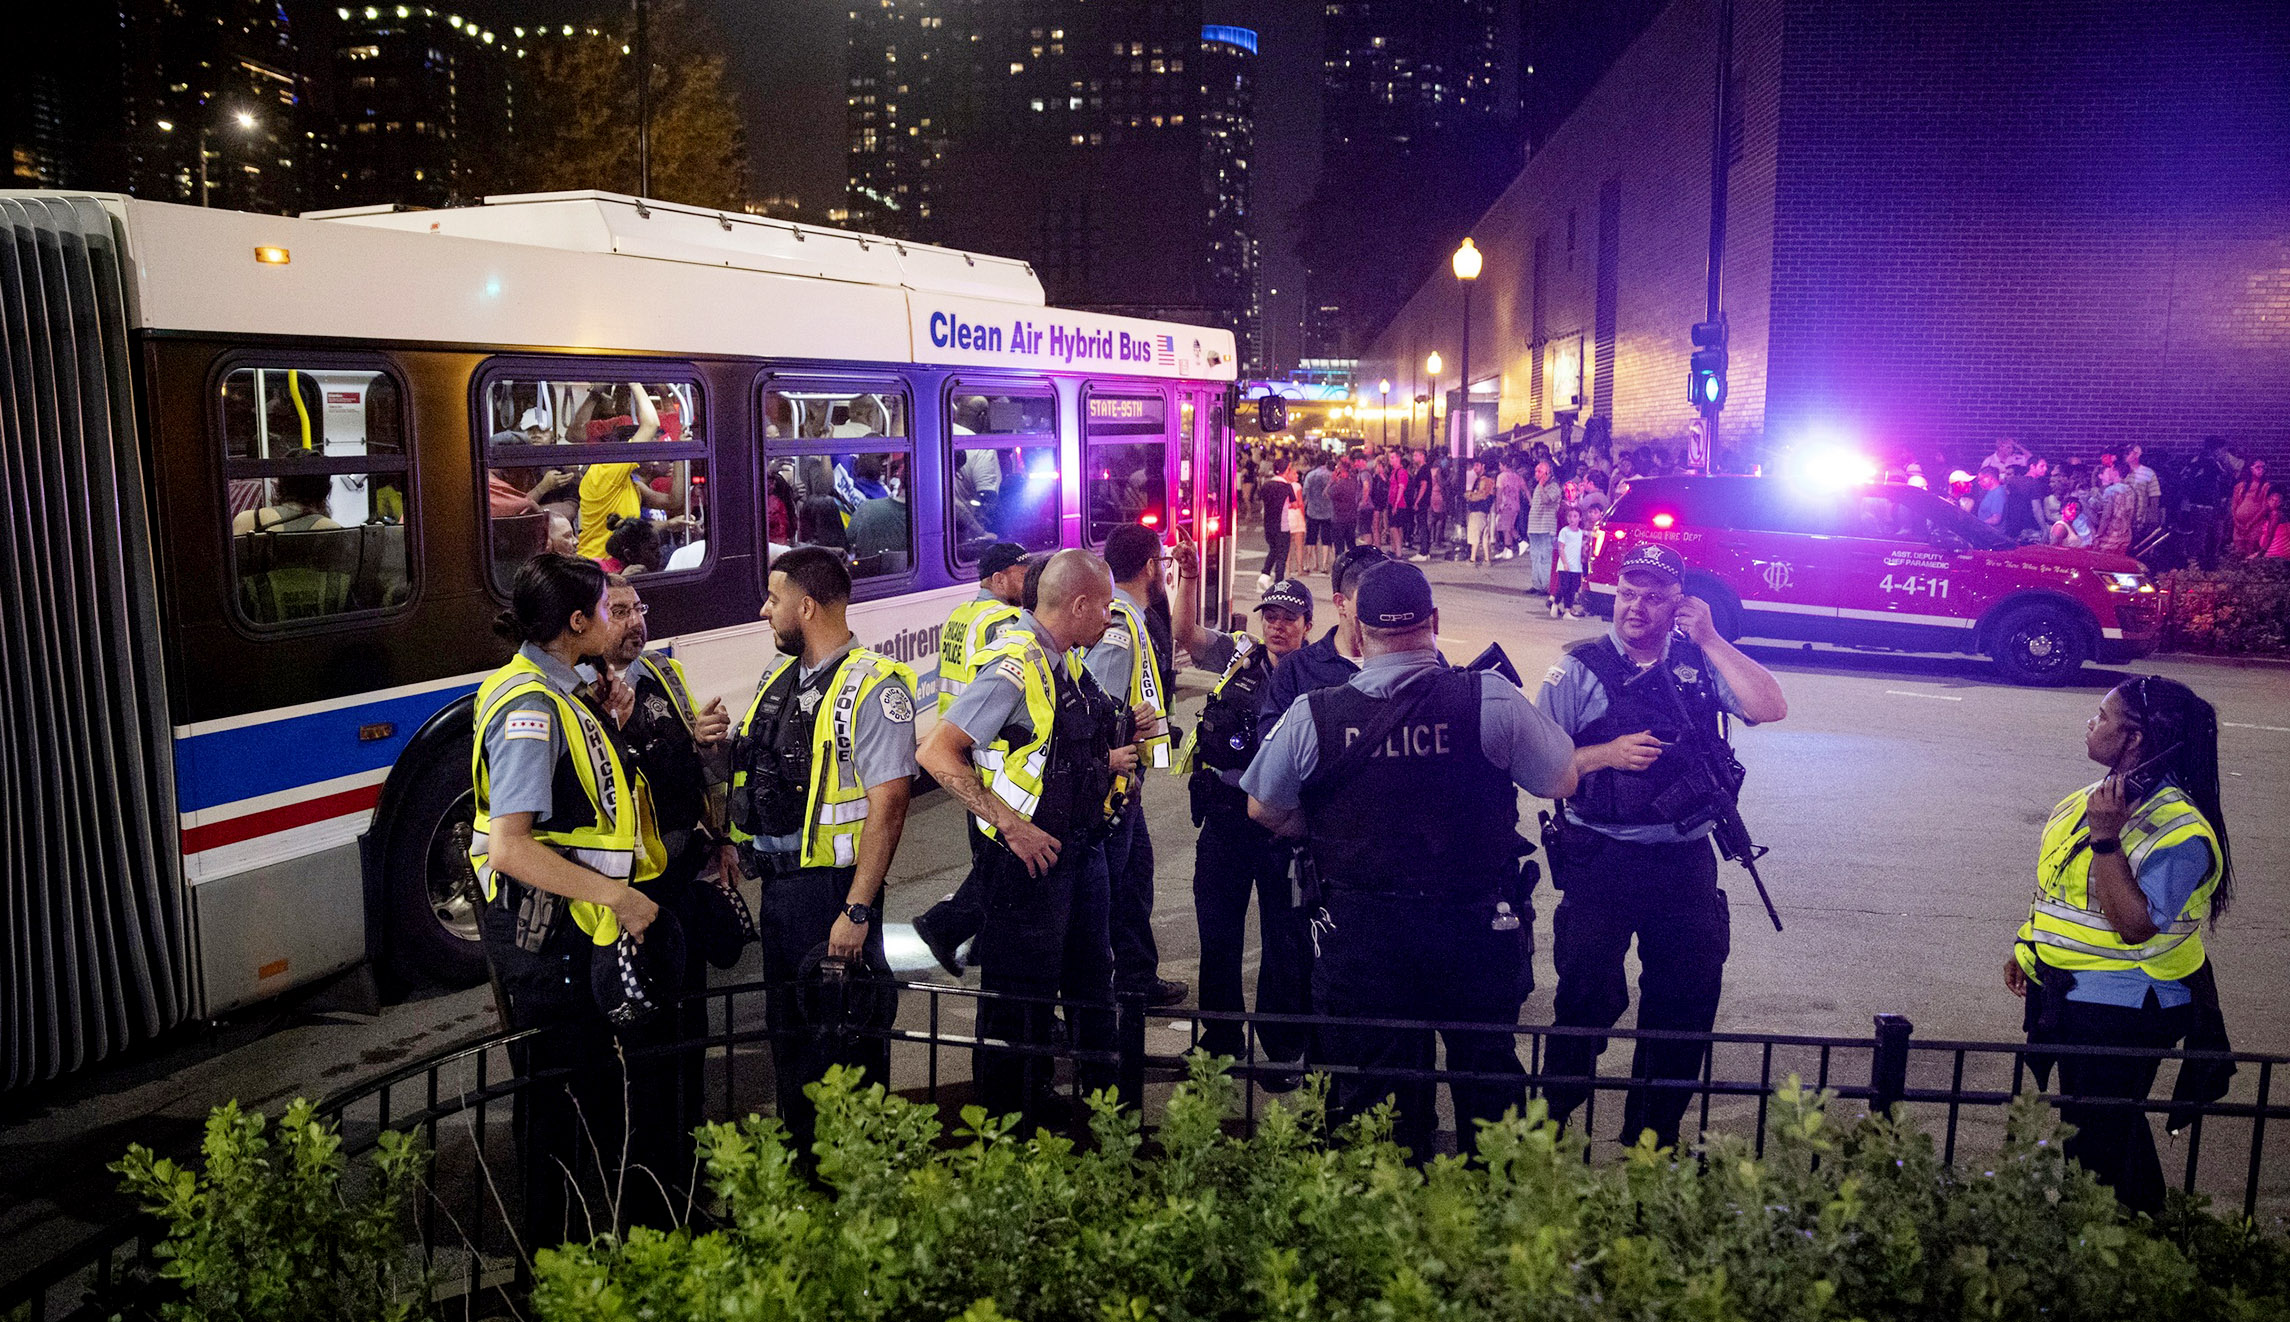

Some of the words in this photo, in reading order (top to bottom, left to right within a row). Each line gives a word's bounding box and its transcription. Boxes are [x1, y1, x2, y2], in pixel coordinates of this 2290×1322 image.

[930, 311, 1001, 352] Clean
[1010, 321, 1043, 355] Air
[1050, 325, 1112, 363] Hybrid
[1119, 332, 1151, 362] Bus
[1905, 559, 1949, 569] PARAMEDIC
[1914, 552, 1943, 560] DEPUTY
[1880, 574, 1949, 598] 4-4-11
[1380, 612, 1414, 622] CPD
[942, 641, 962, 665] POLICE
[1139, 631, 1154, 698] CHICAGO
[835, 685, 857, 762] POLICE
[1345, 722, 1450, 758] PLICE
